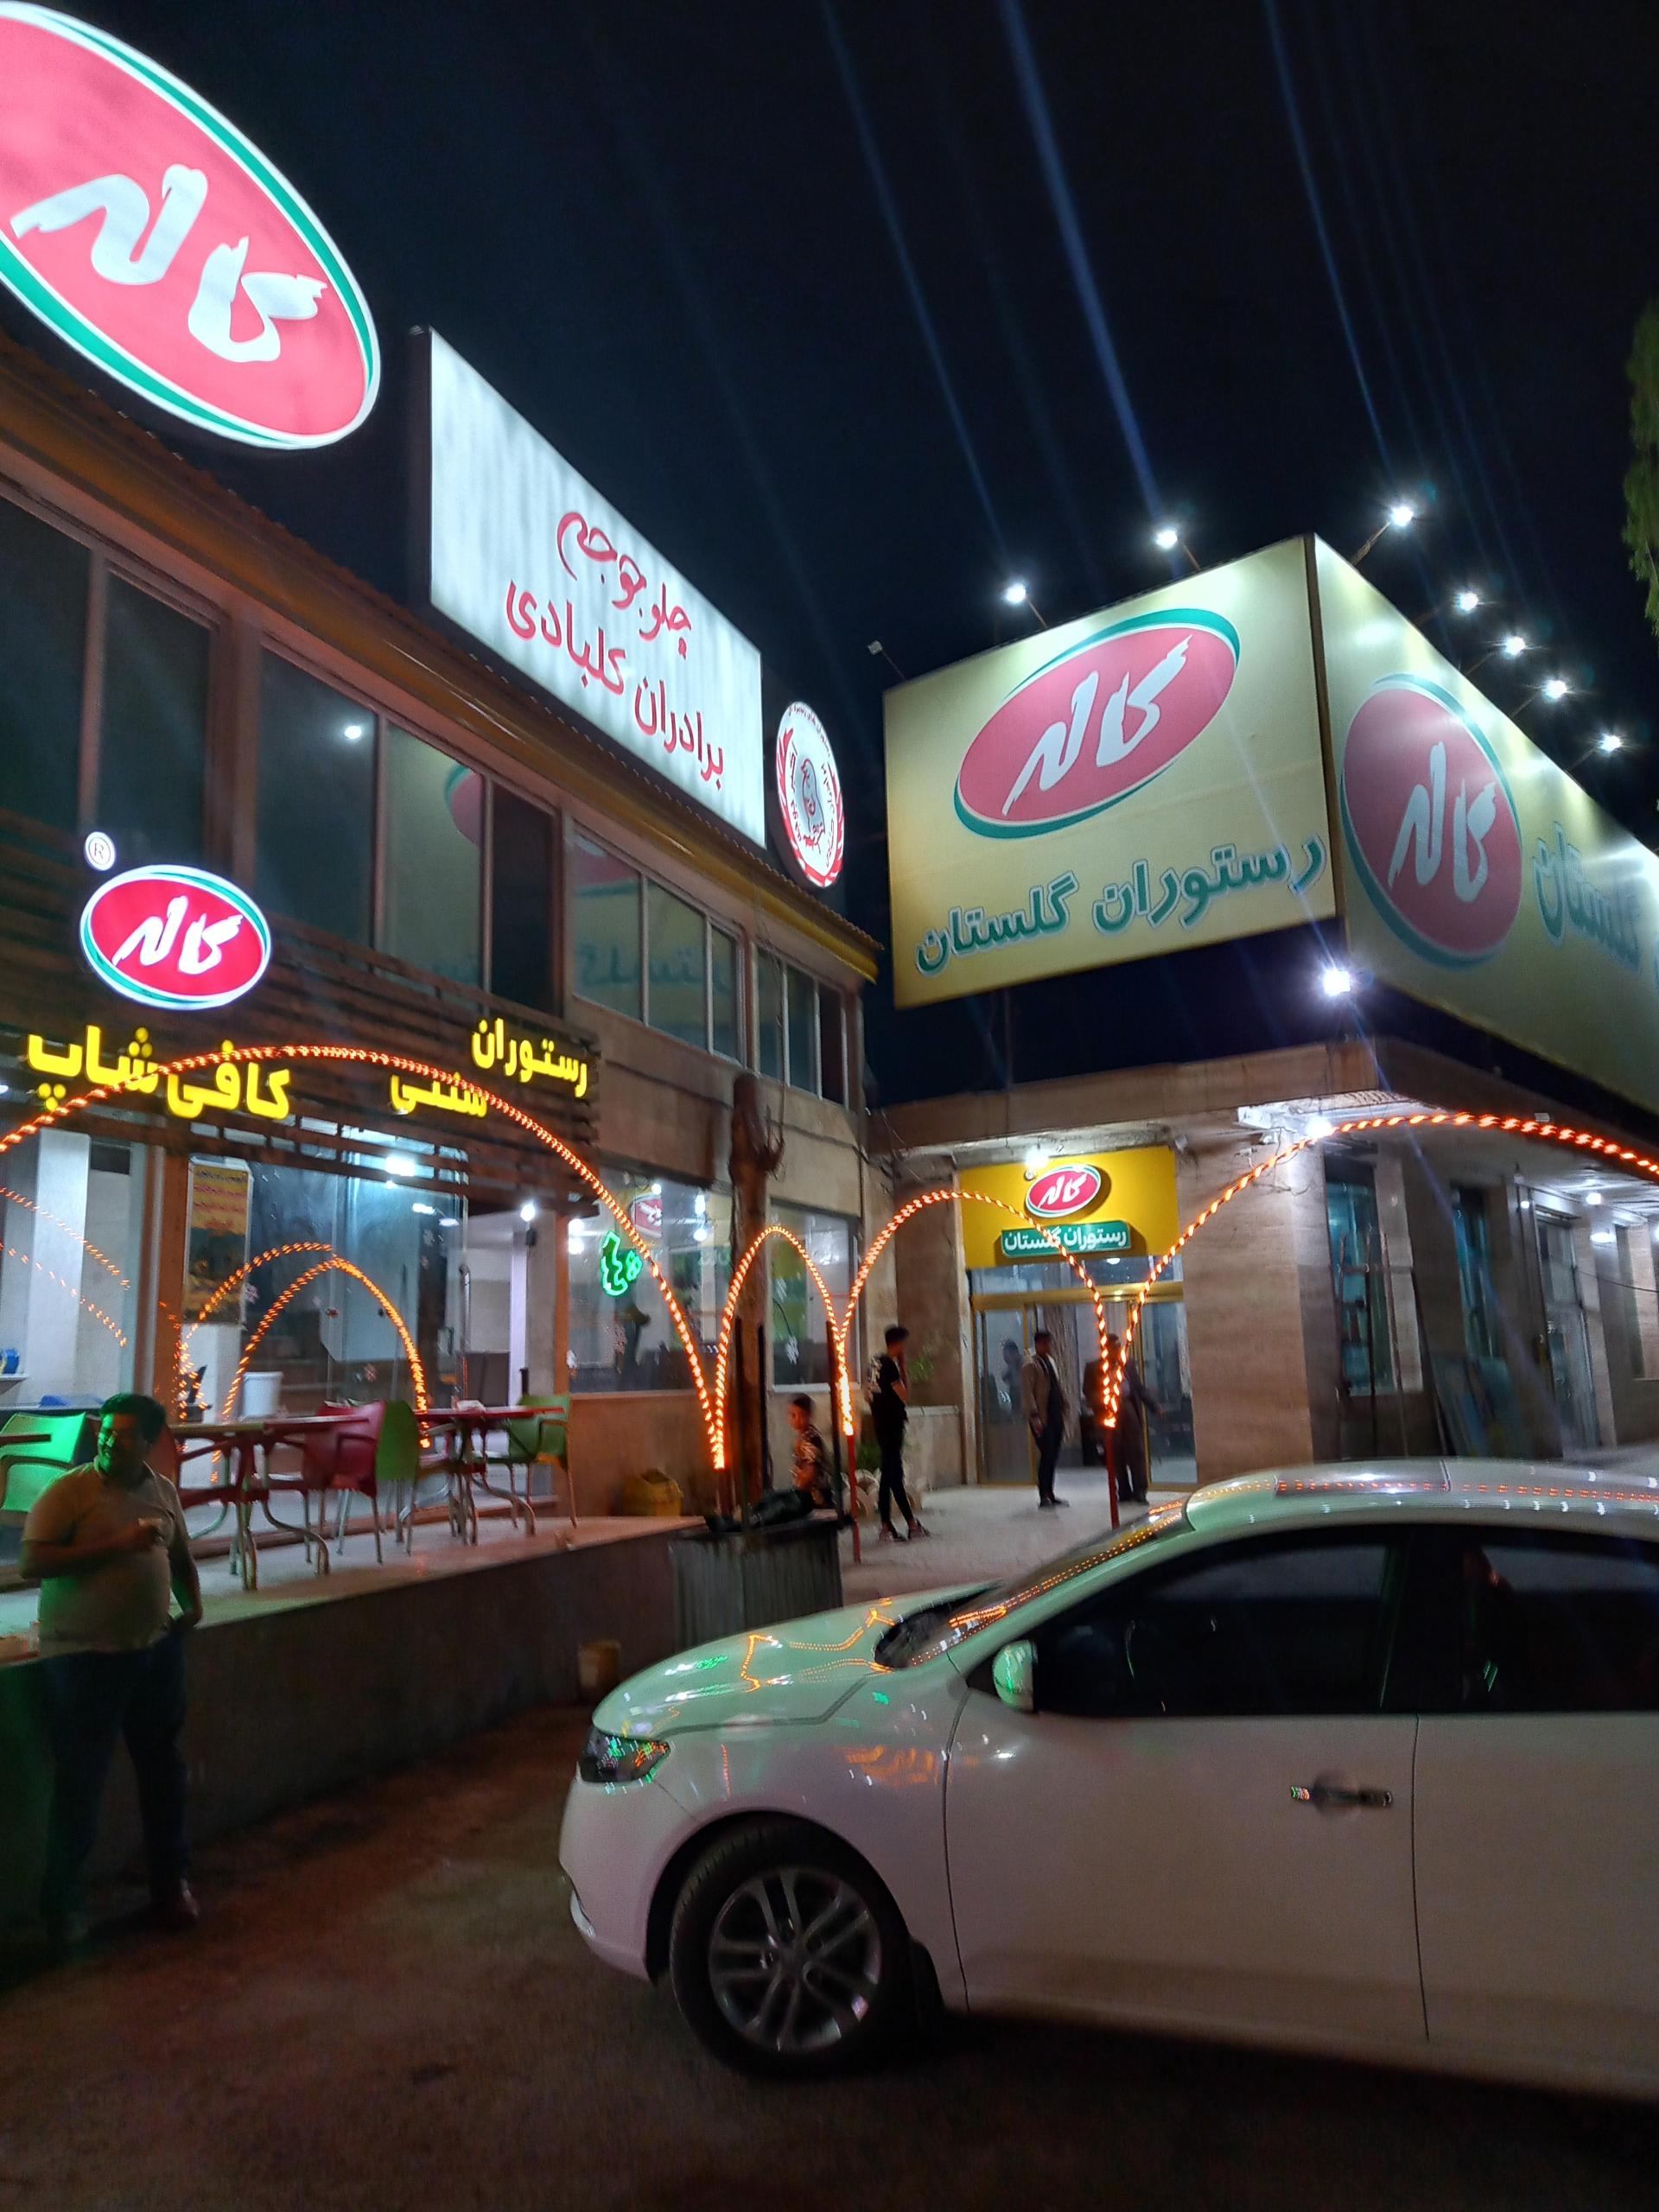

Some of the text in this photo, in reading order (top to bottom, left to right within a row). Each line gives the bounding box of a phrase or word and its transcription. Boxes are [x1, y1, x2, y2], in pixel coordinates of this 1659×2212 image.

[10, 164, 327, 363] کاله
[506, 579, 626, 696] کلبادی
[635, 677, 724, 791] برادران
[1001, 634, 1193, 817] کاله
[1388, 740, 1498, 903] کاله
[111, 895, 244, 975] کاله
[916, 835, 1327, 976] رستوران گلستان
[28, 1025, 290, 1120] کافی شاپ
[472, 1017, 588, 1098] رستوران
[1038, 1173, 1089, 1209] کاله
[1063, 1226, 1128, 1251] رستوران
